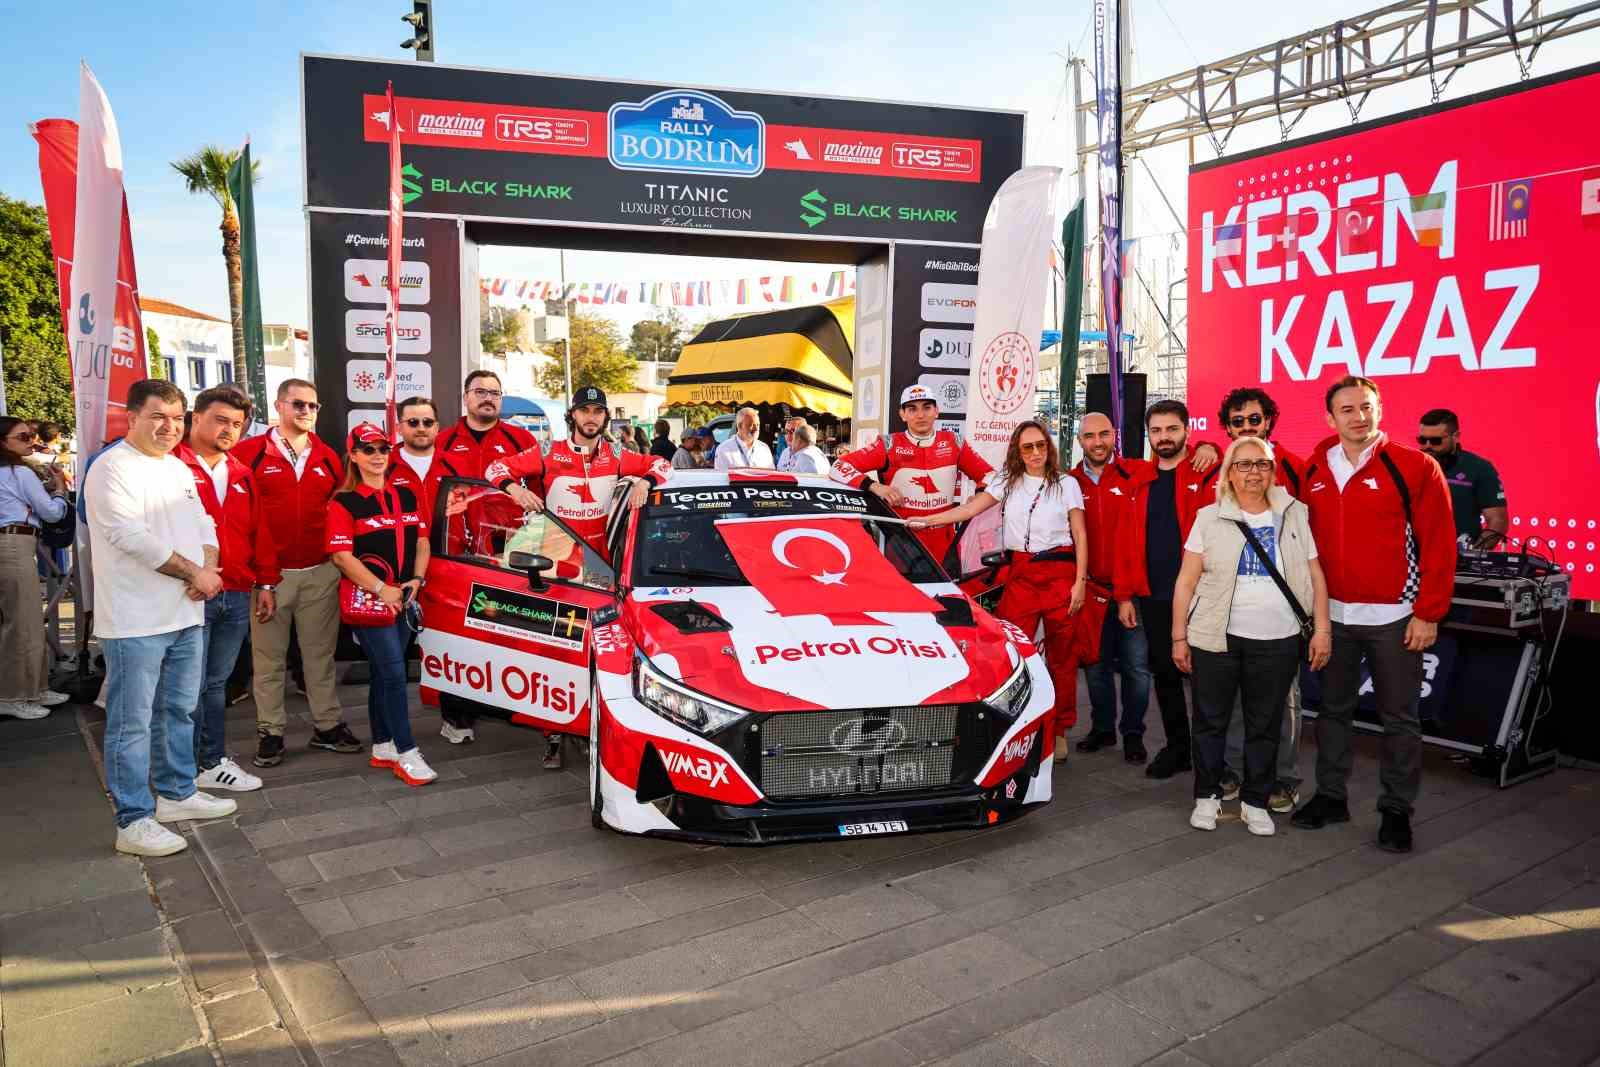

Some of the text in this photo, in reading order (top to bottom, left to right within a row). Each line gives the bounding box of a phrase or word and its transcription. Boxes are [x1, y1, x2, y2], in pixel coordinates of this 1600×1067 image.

[418, 113, 485, 129] maxima
[498, 119, 553, 139] TRS
[660, 121, 714, 136] RALLY
[620, 134, 753, 165] BODRUM
[824, 141, 883, 158] maxima
[895, 147, 942, 166] TRS
[432, 178, 572, 200] BLACK SHARK
[645, 184, 728, 202] TITANIC
[621, 202, 751, 219] LUXURY COLLECTION
[834, 203, 957, 223] BLACK SHARK
[1201, 160, 1457, 292] KEREM
[381, 273, 424, 285] mxima
[355, 327, 421, 337] SPOROTO
[1260, 264, 1540, 383] KAZAZ
[701, 384, 730, 400] COFFEE
[664, 487, 868, 507] Team Petrol Ofisi
[520, 607, 553, 622] SHARK
[566, 609, 576, 637] 1
[755, 636, 947, 664] Petrol Ofisi
[420, 652, 575, 714] etrol Ofisi
[808, 762, 924, 788] HYUNDAI
[846, 824, 863, 835] SB
[867, 823, 878, 832] 14
